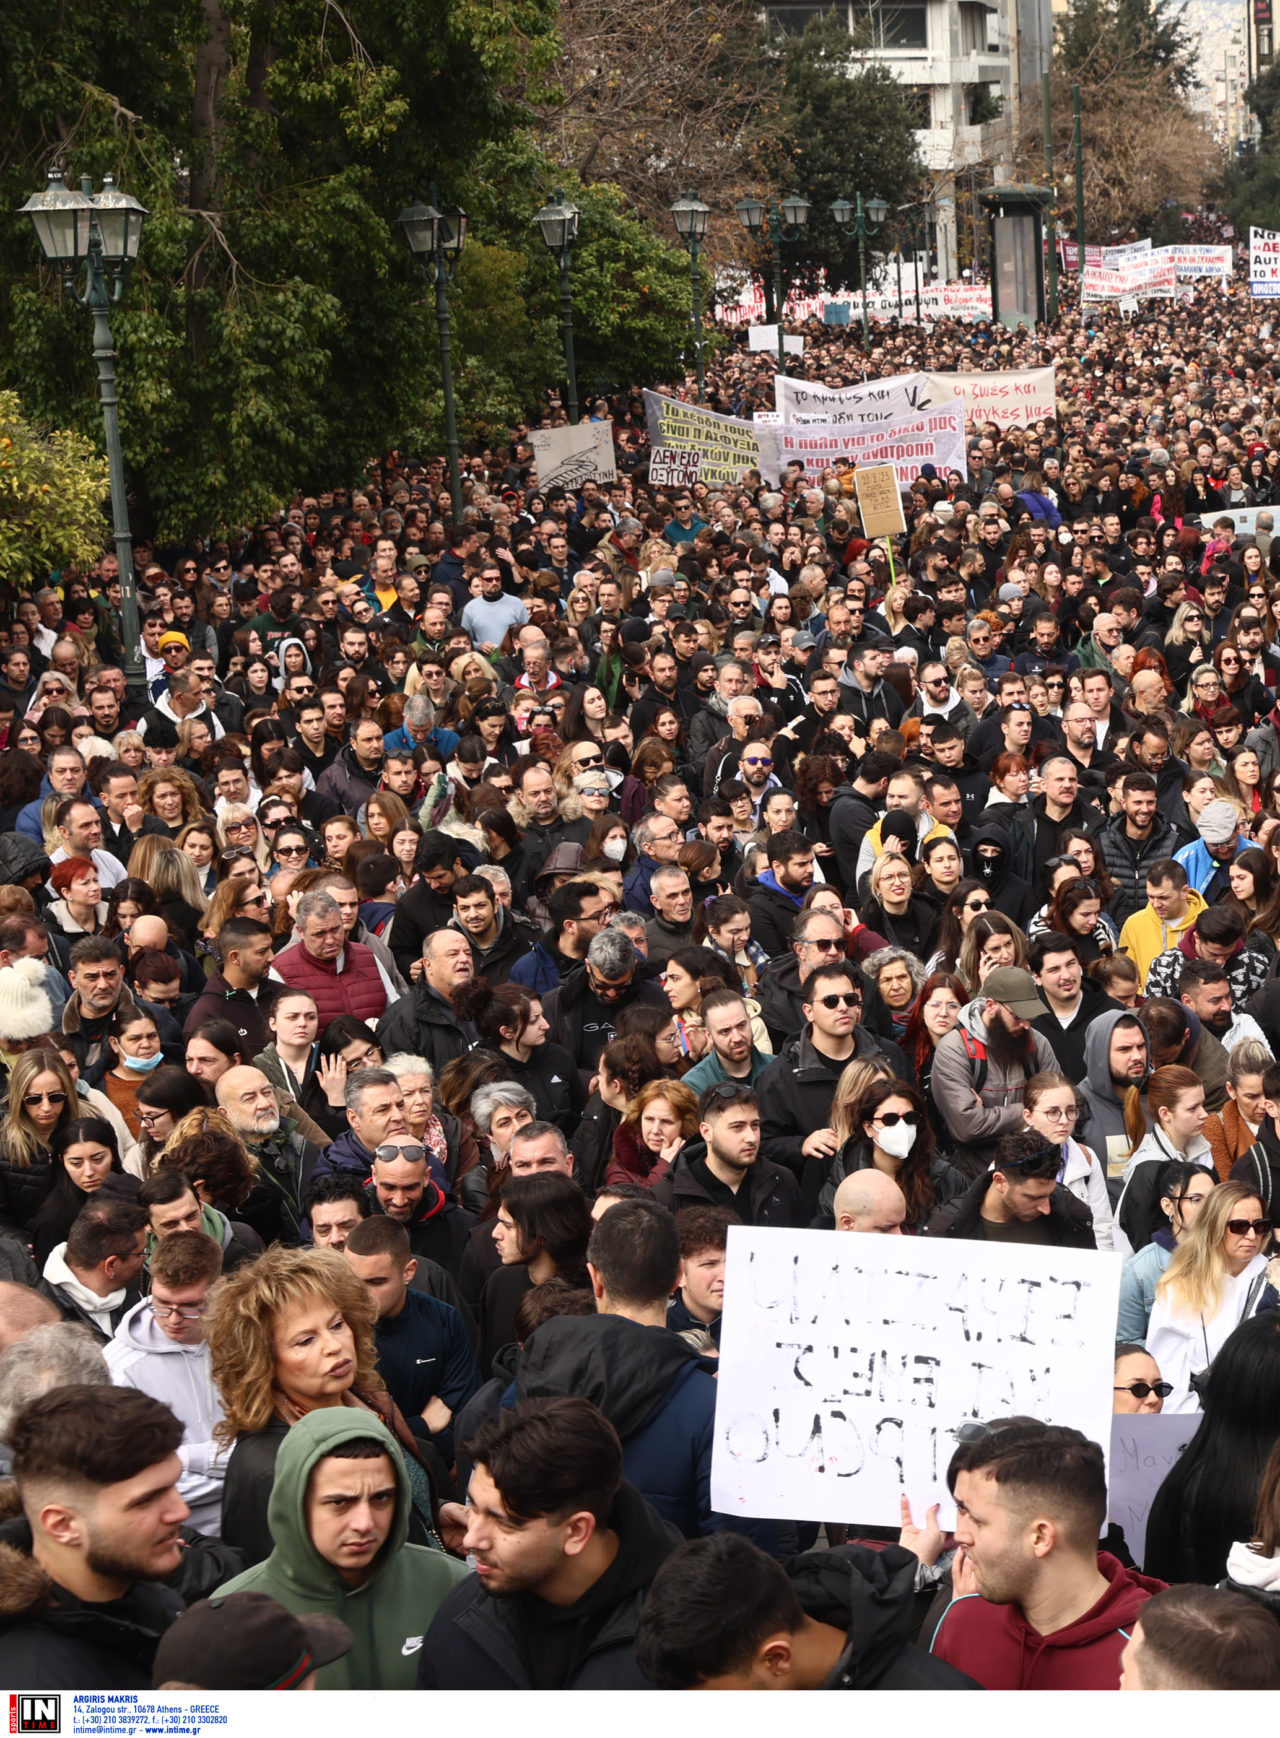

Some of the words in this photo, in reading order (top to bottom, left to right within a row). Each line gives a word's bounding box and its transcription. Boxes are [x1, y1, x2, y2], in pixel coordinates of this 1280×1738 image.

[969, 382, 1010, 400] ζωές
[664, 402, 679, 417] Τα
[682, 410, 720, 430] κέρδη
[724, 423, 753, 439] τους
[783, 436, 794, 449] Η
[798, 436, 839, 450] πάλη
[842, 436, 866, 450] για
[869, 433, 885, 443] το
[929, 414, 957, 435] μας
[659, 421, 689, 437] είναι
[705, 427, 760, 453] ΑΣΦΥΞΙΑ
[653, 450, 677, 465] ΔΕΝ
[680, 451, 700, 467] ΕΧΩ
[732, 453, 758, 467] μας
[806, 457, 830, 469] και
[862, 439, 934, 461] ανατροπή
[650, 467, 698, 484] ΟΞΥΓΟΝΟ
